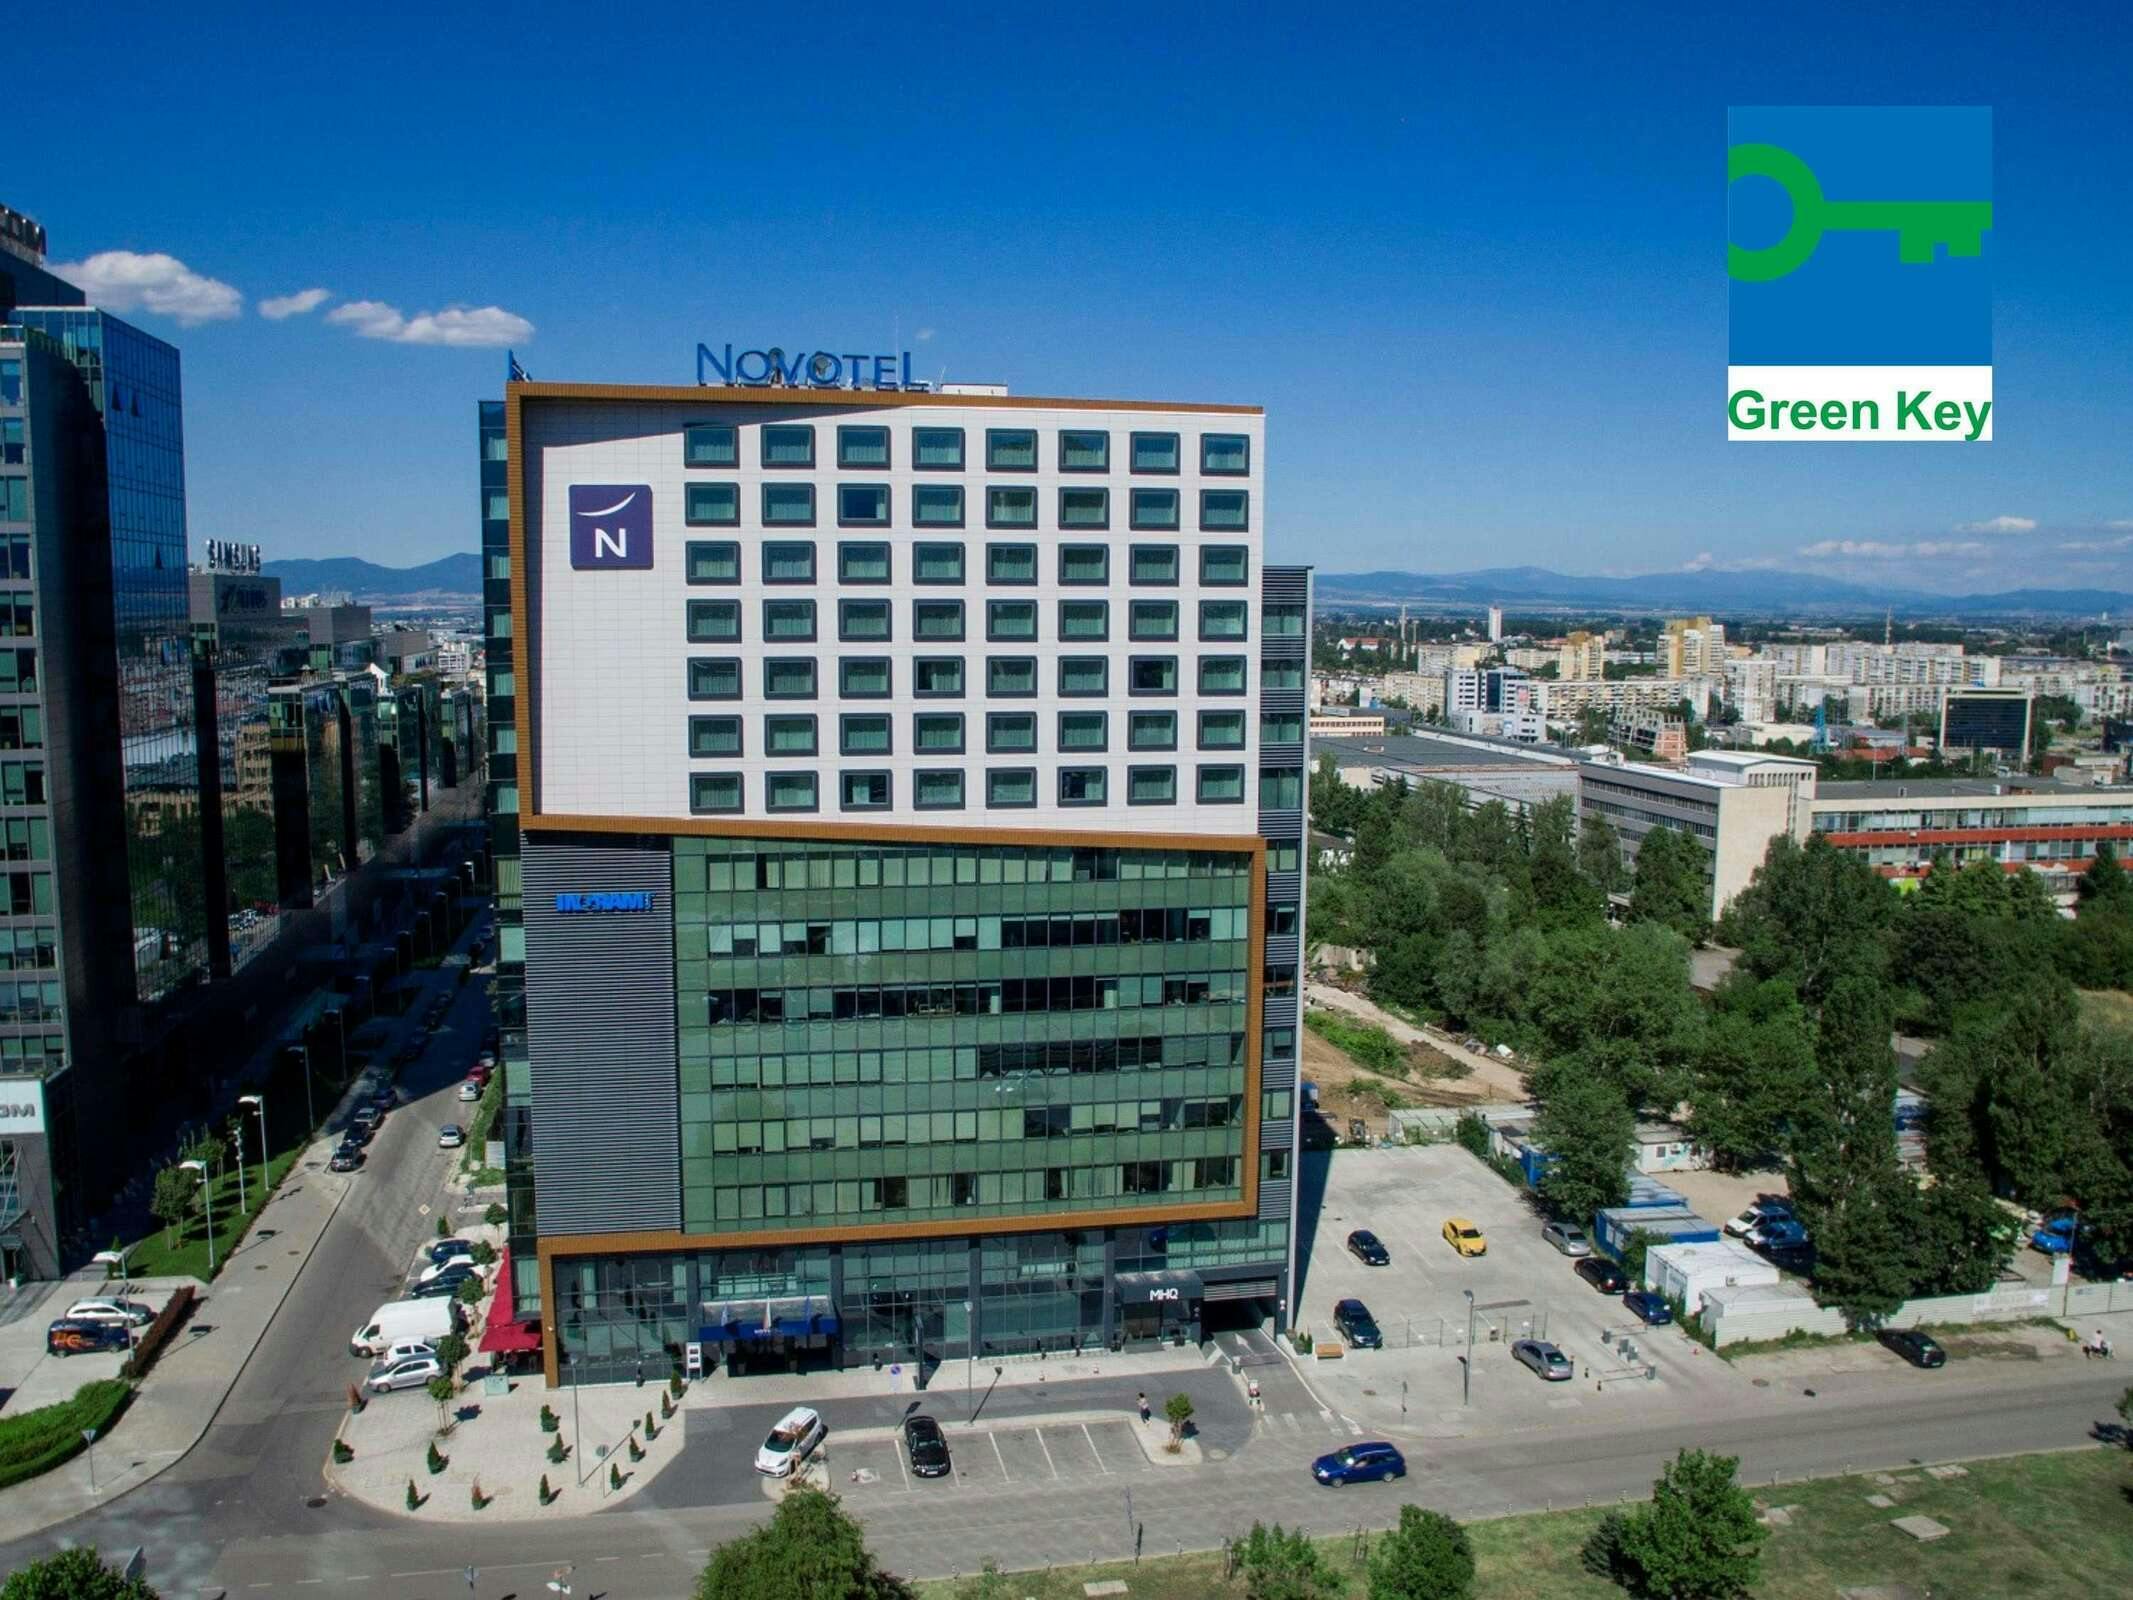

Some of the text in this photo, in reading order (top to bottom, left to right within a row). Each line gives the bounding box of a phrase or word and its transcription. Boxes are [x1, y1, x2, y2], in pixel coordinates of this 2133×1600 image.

[697, 343, 929, 388] NOVOTEL
[595, 528, 627, 559] N
[1149, 1288, 1179, 1301] MHQ
